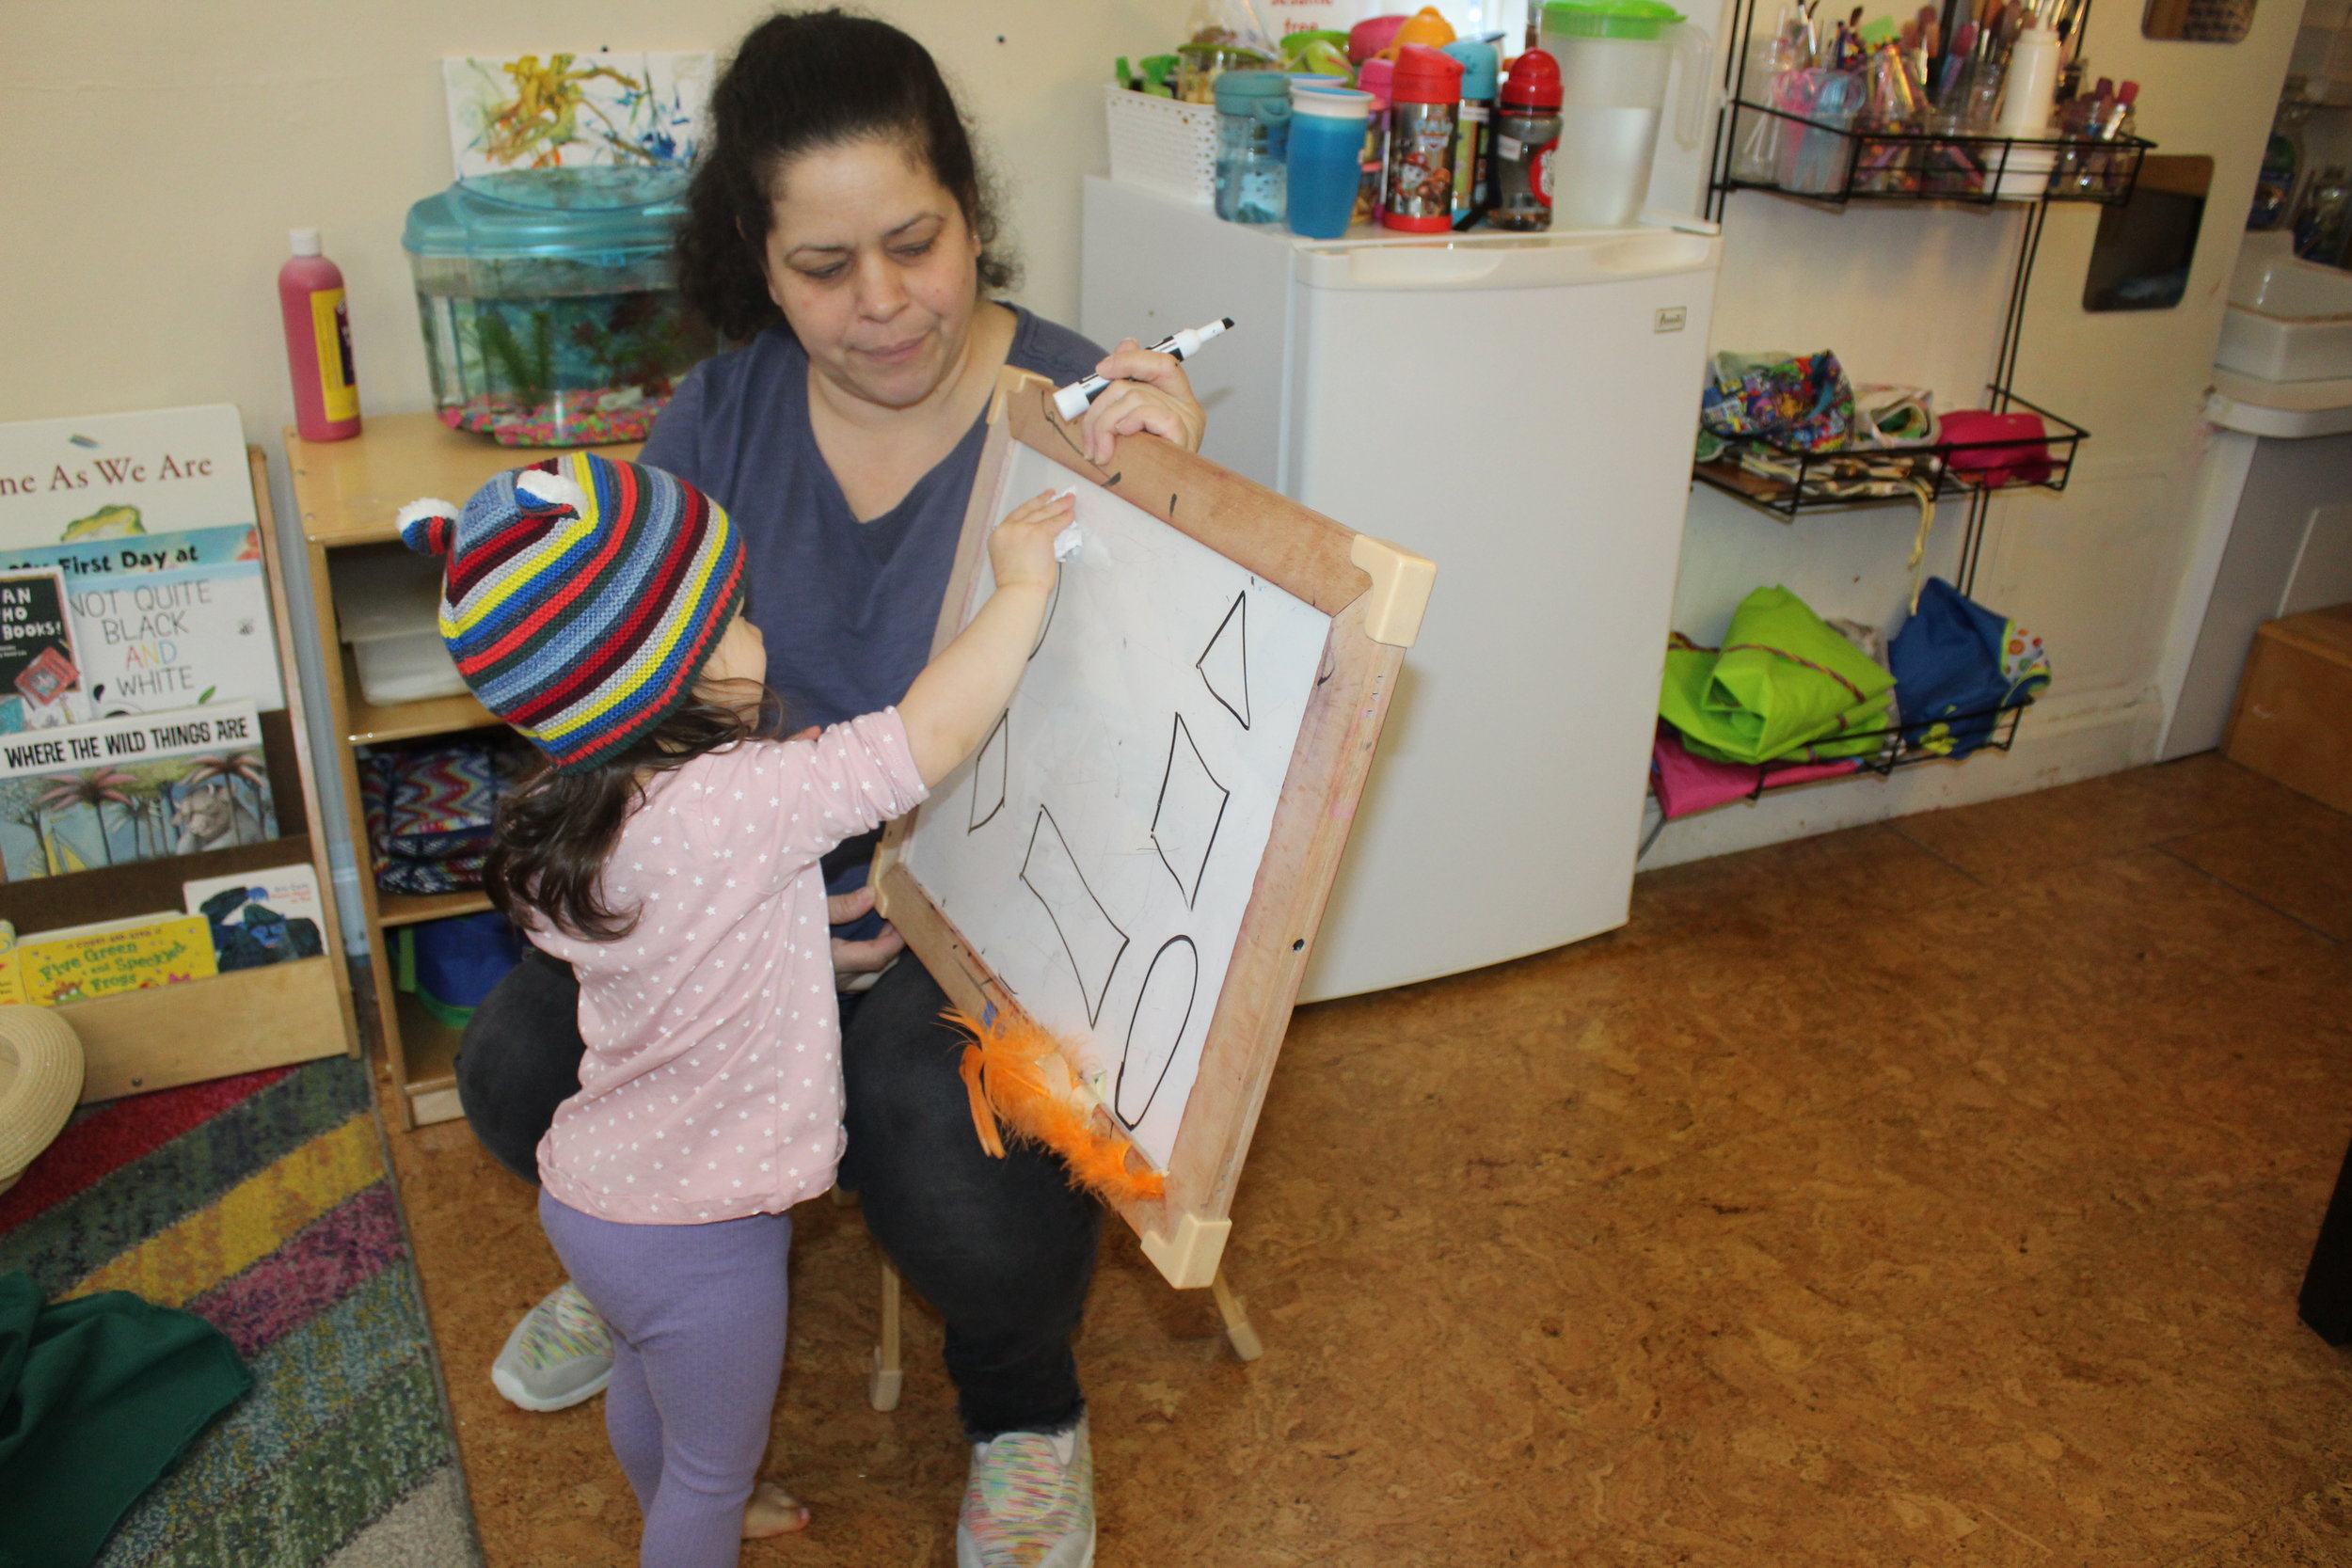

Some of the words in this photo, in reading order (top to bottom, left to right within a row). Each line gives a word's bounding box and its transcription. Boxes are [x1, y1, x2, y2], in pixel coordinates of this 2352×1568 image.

[1284, 18, 1318, 34] free
[0, 475, 37, 496] ne
[50, 464, 89, 492] As
[93, 457, 147, 485] We
[158, 453, 213, 481] Are
[58, 554, 112, 575] First
[121, 549, 167, 570] Day
[176, 546, 199, 562] at
[69, 589, 119, 618] NOT
[135, 578, 212, 611] QUITE
[101, 610, 189, 645] BLACK
[126, 640, 178, 671] AND
[116, 665, 195, 697] WHITE
[4, 740, 66, 768] WHERE
[68, 736, 101, 761] THE
[105, 730, 146, 756] WILD
[150, 721, 211, 750] THINGS
[215, 717, 248, 740] ARE
[40, 957, 82, 981] Five
[83, 942, 138, 962] Green
[114, 940, 186, 972] Speckled
[90, 973, 137, 992] Frogs
